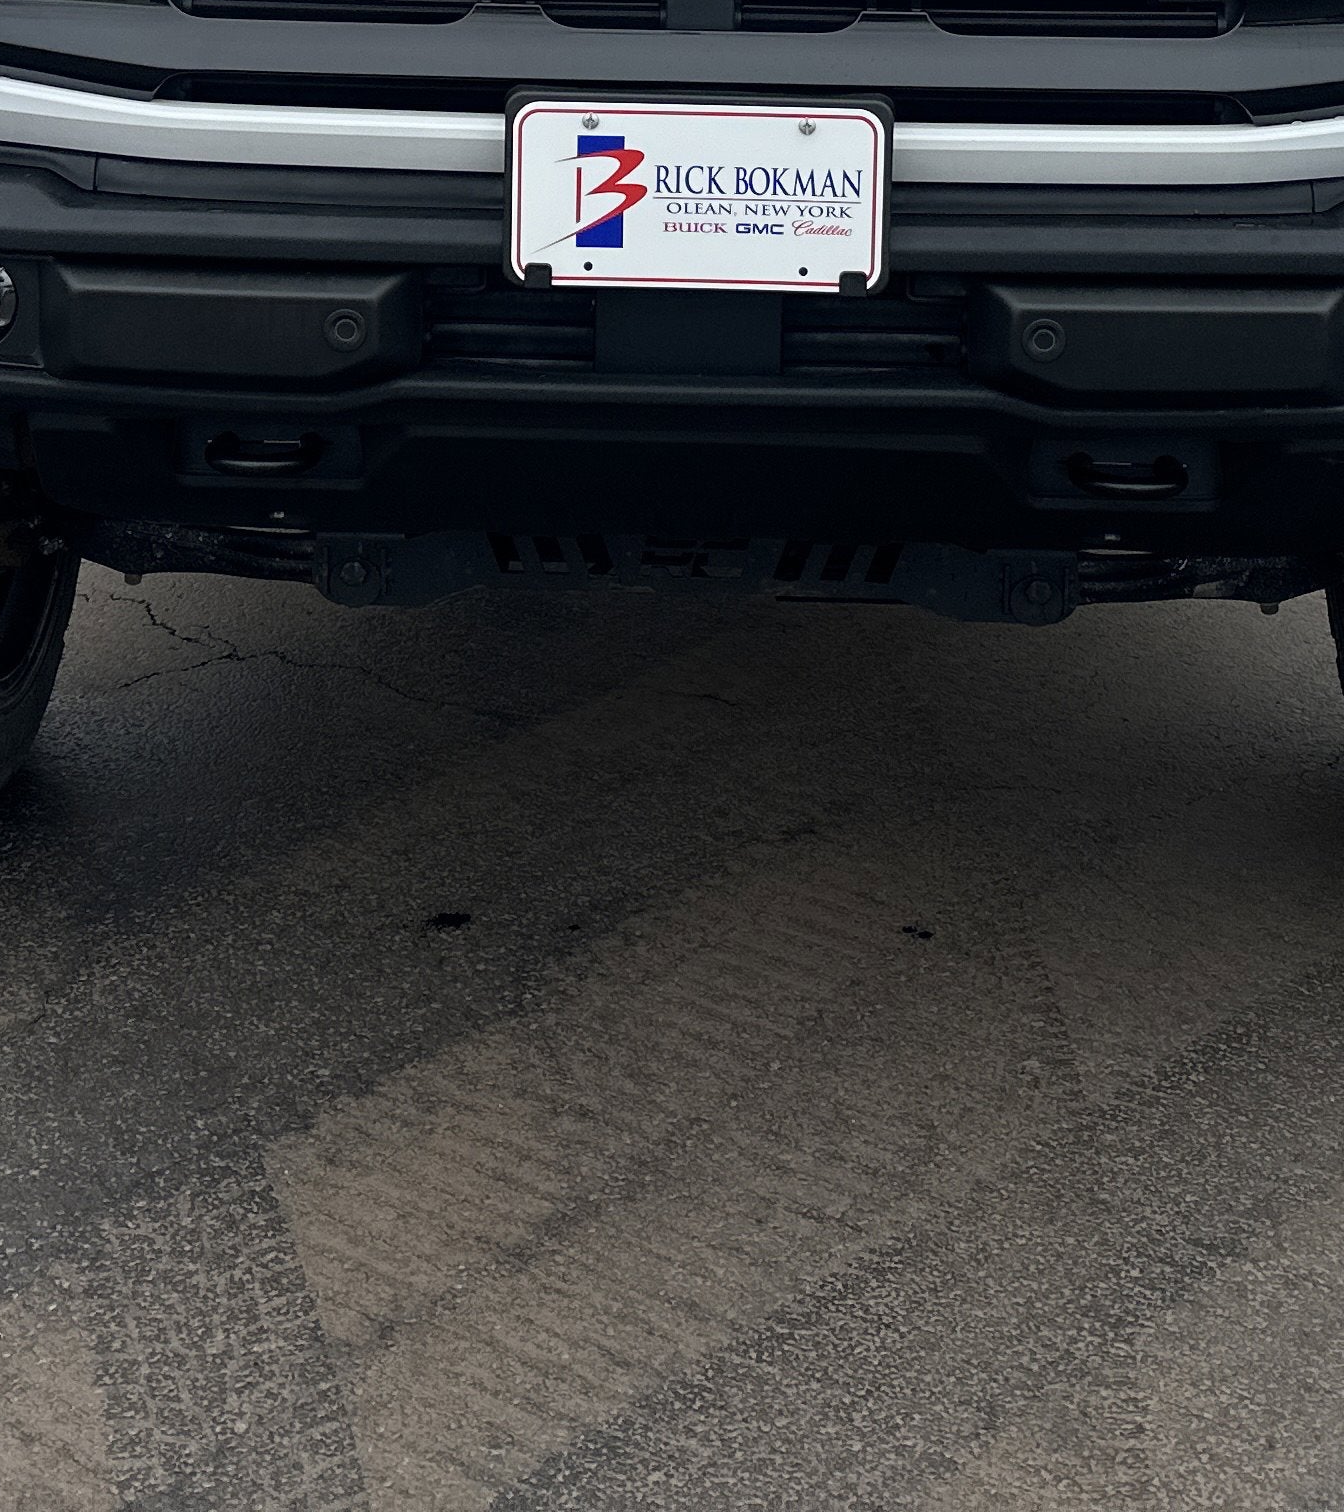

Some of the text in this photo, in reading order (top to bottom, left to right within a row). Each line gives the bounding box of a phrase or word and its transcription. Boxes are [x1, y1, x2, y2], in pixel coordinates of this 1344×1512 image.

[653, 164, 863, 198] RICK BOKMAN
[744, 204, 791, 216] NEW
[795, 205, 853, 219] YORK
[663, 220, 853, 237] BUICK GMC Cadillac
